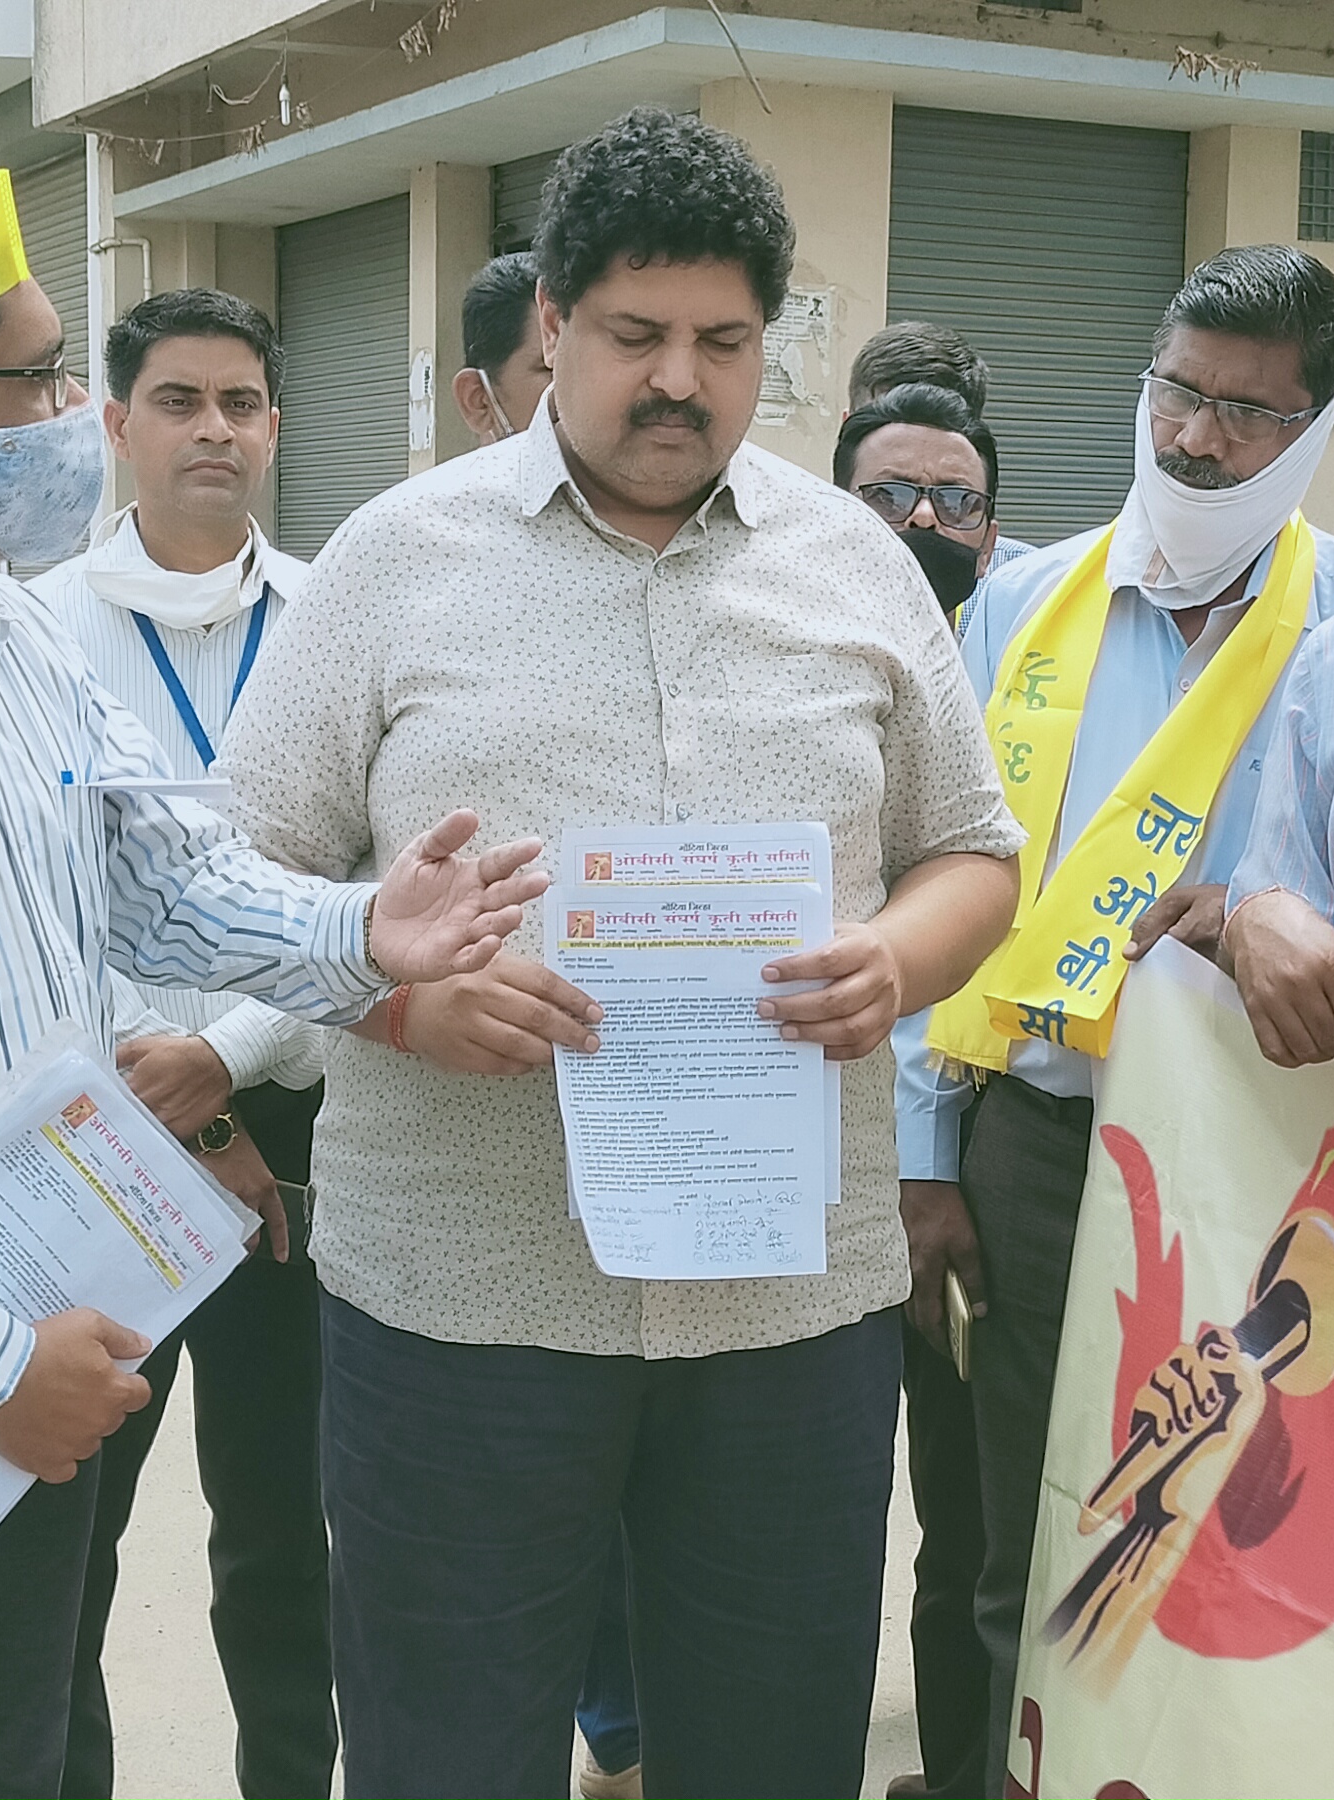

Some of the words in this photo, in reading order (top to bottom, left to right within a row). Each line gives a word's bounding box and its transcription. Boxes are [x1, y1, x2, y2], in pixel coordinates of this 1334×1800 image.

[614, 852, 674, 866] ओबीसी
[681, 851, 718, 865] संघर्ष
[726, 852, 759, 868] कृती
[764, 849, 811, 864] समिती
[596, 911, 656, 925] ओबीसी
[663, 911, 700, 924] संघर्ष
[708, 911, 741, 928] कृती
[748, 910, 798, 923] समिती
[89, 1116, 133, 1166] ओबीसी
[133, 1167, 162, 1196] संघर्ष
[157, 1198, 183, 1226] कृती
[184, 1225, 216, 1266] समिती
